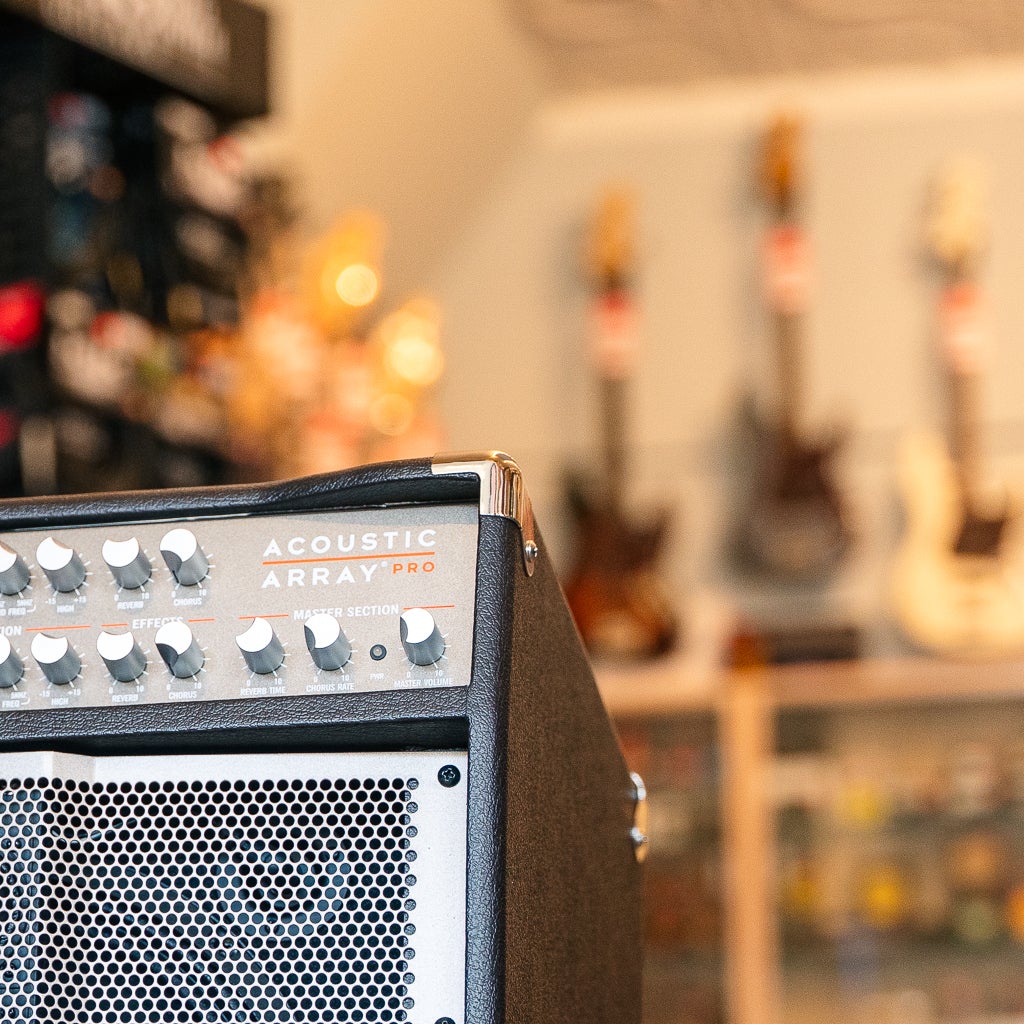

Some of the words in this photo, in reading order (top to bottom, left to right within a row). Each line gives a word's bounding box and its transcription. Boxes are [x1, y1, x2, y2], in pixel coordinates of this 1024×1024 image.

[263, 529, 437, 557] ACOUSTIC
[261, 564, 378, 589] ARRAY
[392, 561, 435, 574] PRO
[117, 601, 144, 609] REVERB
[173, 598, 202, 606] CHORUS
[57, 605, 75, 613] HIGH
[347, 604, 399, 617] SECTION
[306, 684, 335, 693] CHORUS
[337, 682, 354, 691] RATE
[394, 679, 421, 688] MASTER
[424, 678, 453, 687] VOLUME
[168, 691, 197, 700] CHORUS
[240, 687, 267, 696] REVERB
[270, 686, 286, 694] TIME
[51, 698, 69, 706] HIGH
[112, 694, 138, 702] REVERB
[2, 700, 20, 708] FREQ
